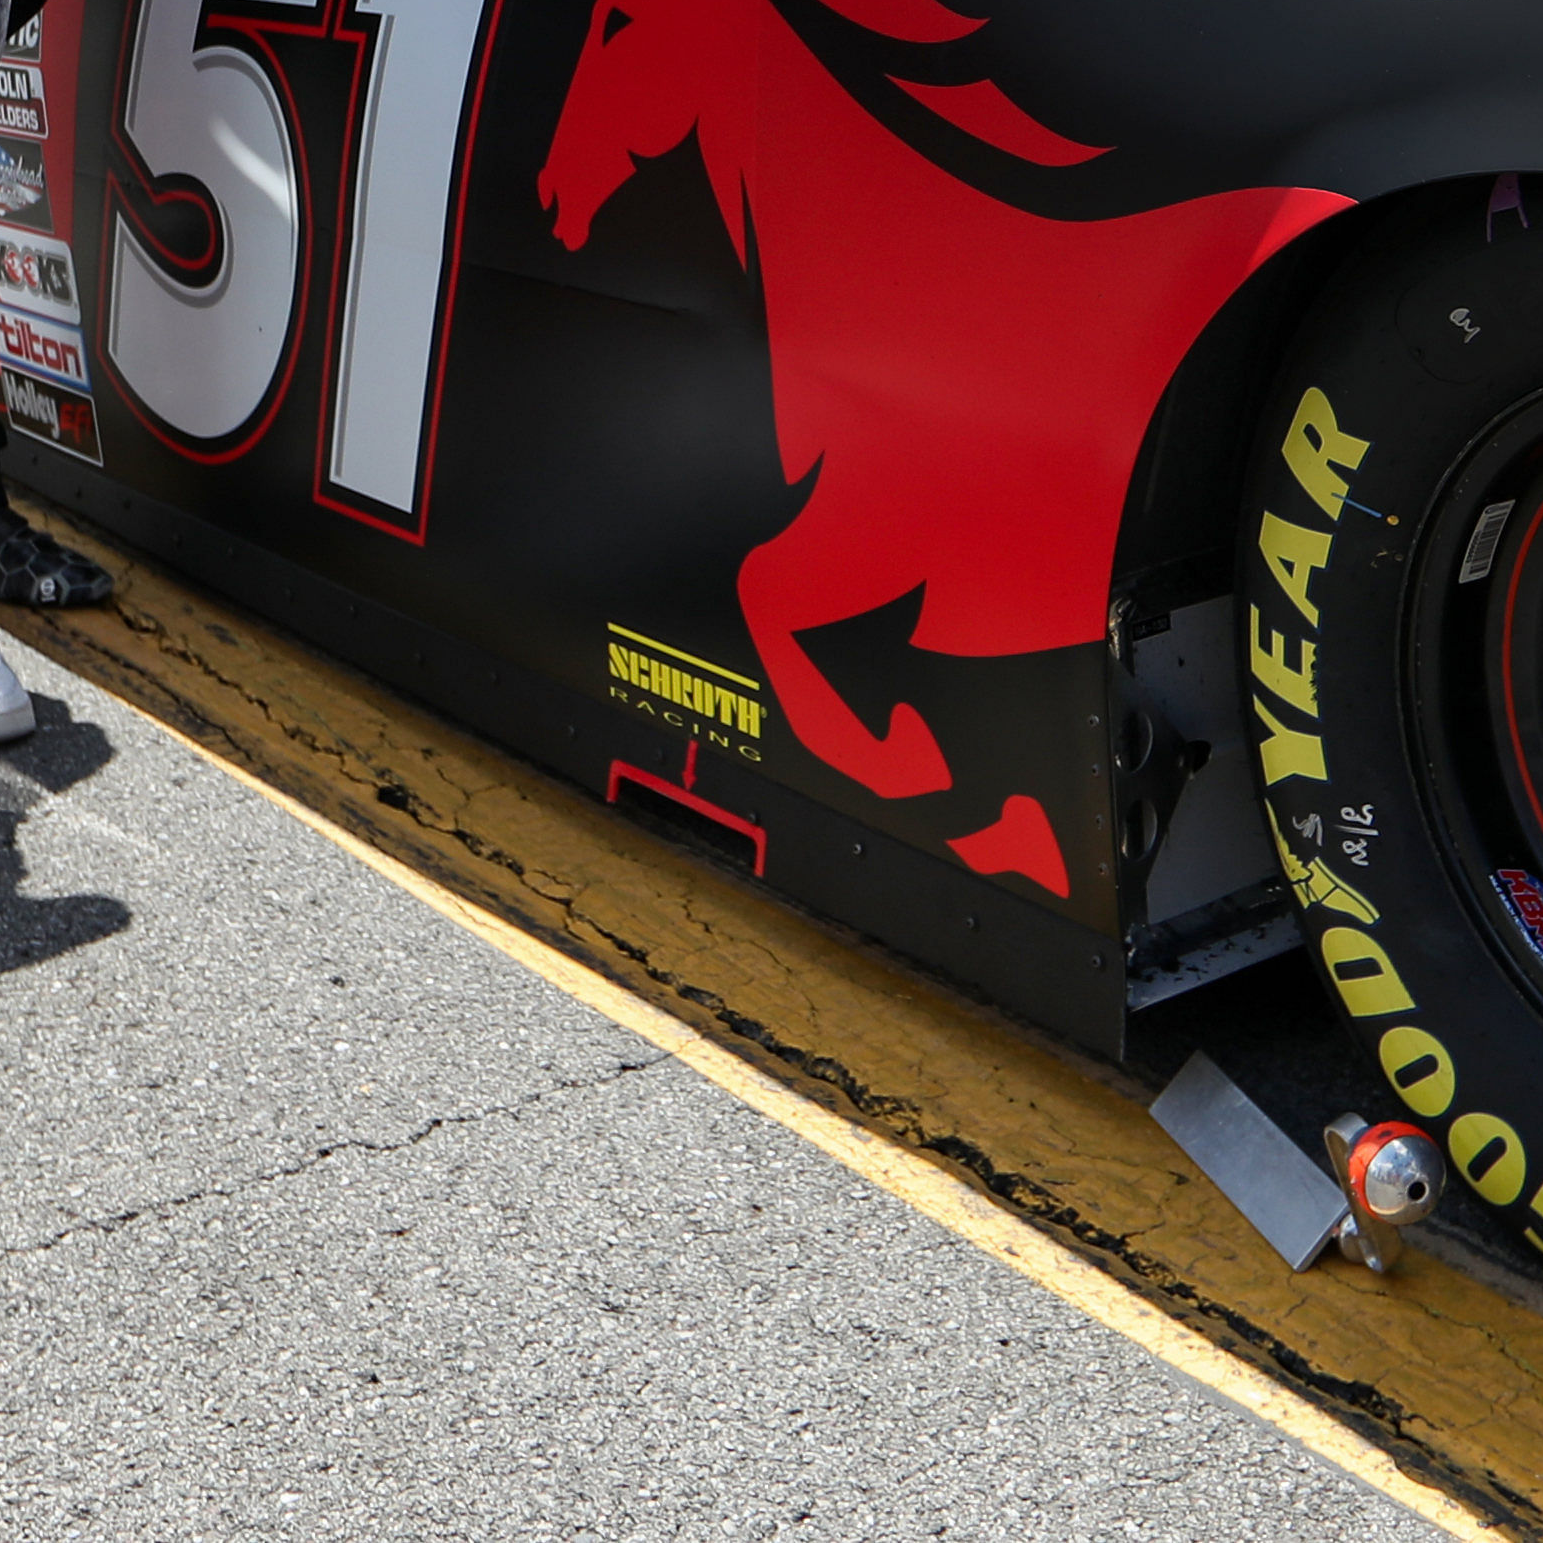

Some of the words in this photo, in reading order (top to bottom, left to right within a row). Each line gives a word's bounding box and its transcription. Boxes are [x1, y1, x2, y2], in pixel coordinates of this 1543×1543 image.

[3, 371, 60, 439] Holley
[609, 642, 761, 739] SCHROTH
[610, 686, 762, 762] RACING
